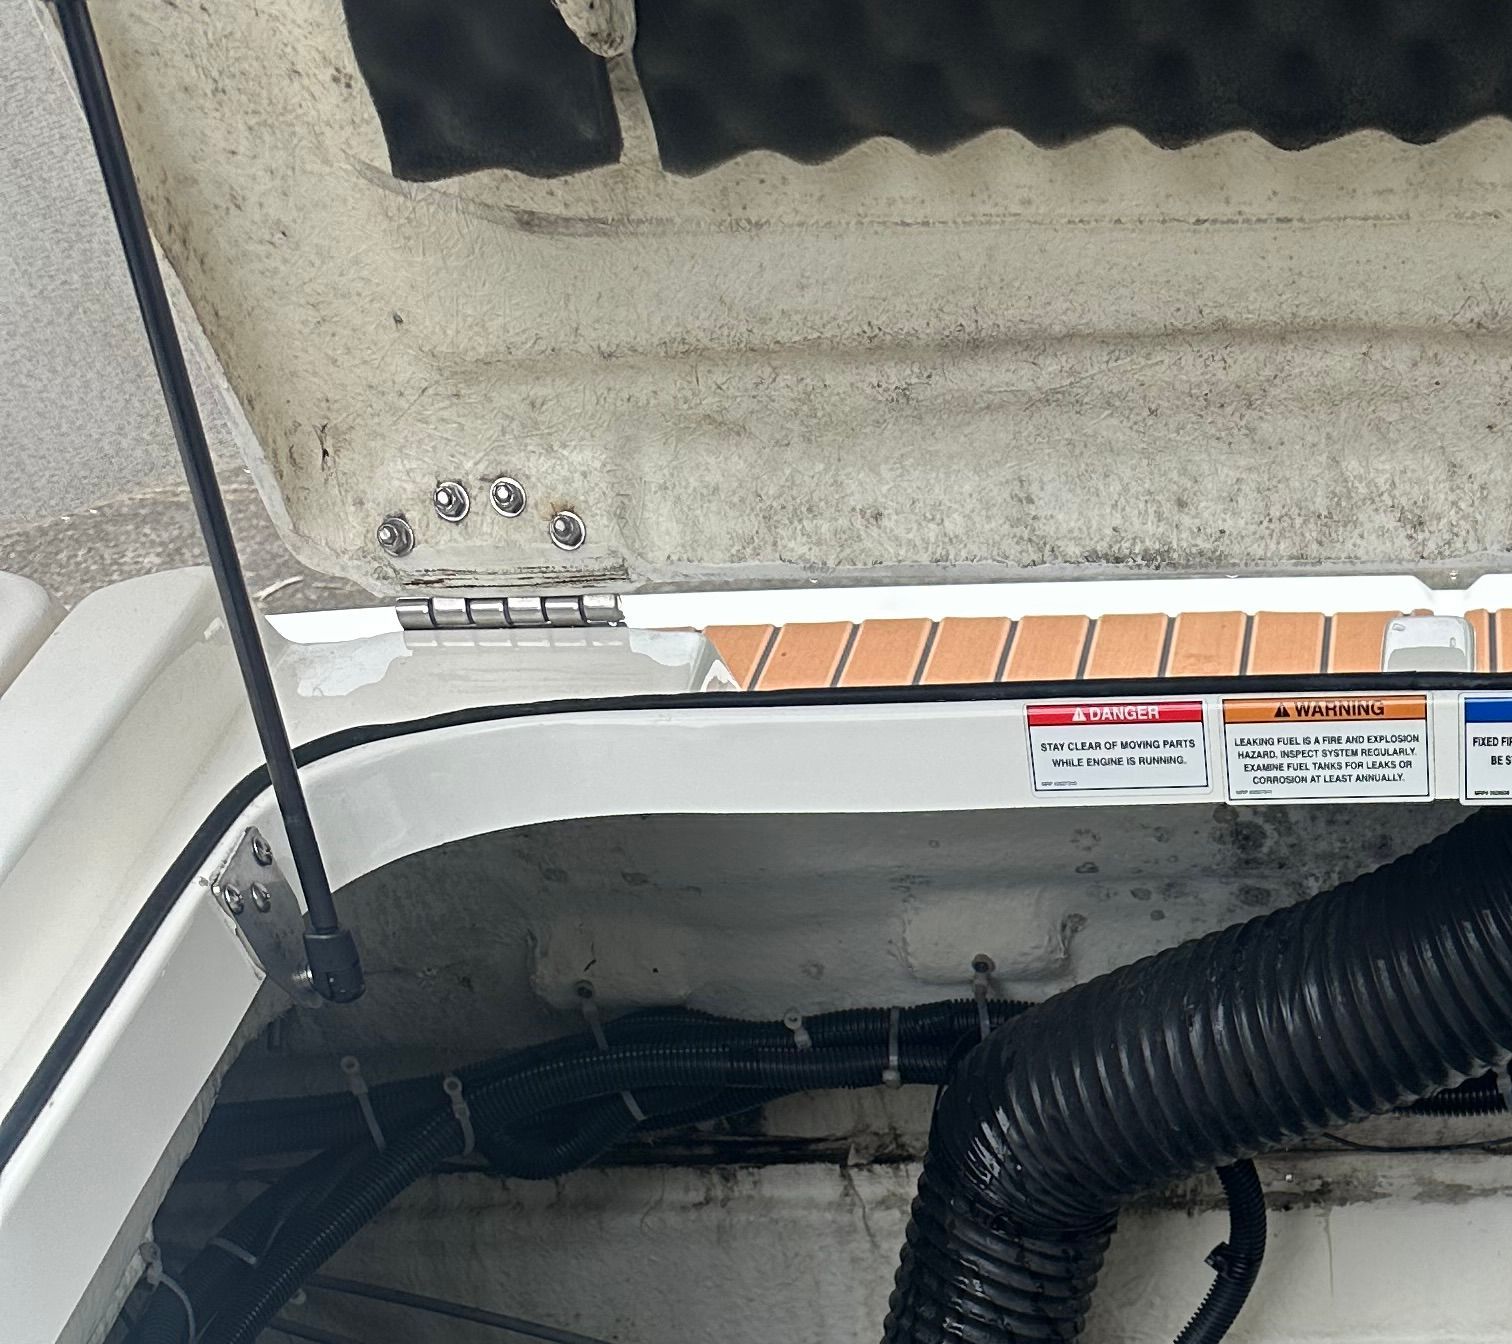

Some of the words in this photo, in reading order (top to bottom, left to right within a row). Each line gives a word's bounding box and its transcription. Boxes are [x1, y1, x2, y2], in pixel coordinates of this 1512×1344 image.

[1090, 705, 1159, 721] DANGER
[1295, 700, 1384, 717] WARNING
[1041, 742, 1064, 751] STAY
[1068, 741, 1100, 751] CLEAR
[1104, 741, 1117, 750] OF
[1121, 740, 1160, 749] MOVING
[1163, 739, 1195, 748] PARTS
[1234, 737, 1274, 746] LEAKING
[1277, 737, 1300, 745] FUEL
[1303, 737, 1311, 745] IS
[1323, 736, 1342, 744] FIRE
[1345, 735, 1364, 744] AND
[1367, 735, 1419, 743] EXPLOSION
[1473, 737, 1498, 746] FIXED
[1281, 750, 1318, 758] INSPECT
[1321, 749, 1358, 757] SYSTEM
[1361, 747, 1416, 756] REGULARLY.
[1052, 758, 1084, 767] WHILE
[1087, 758, 1123, 766] ENGINE
[1127, 757, 1135, 765] IS
[1139, 756, 1187, 765] RUNNING.
[1491, 755, 1503, 765] BE
[1244, 763, 1284, 772] EXAMINE
[1287, 762, 1310, 771] FUEL
[1312, 762, 1342, 770] TANKS
[1345, 761, 1363, 769] FOR
[1366, 761, 1396, 769] LEAKS
[1253, 775, 1307, 784] CORROSION
[1310, 775, 1321, 783] AT
[1324, 774, 1352, 783] LEAST
[1355, 773, 1405, 782] ANNUALLY.
